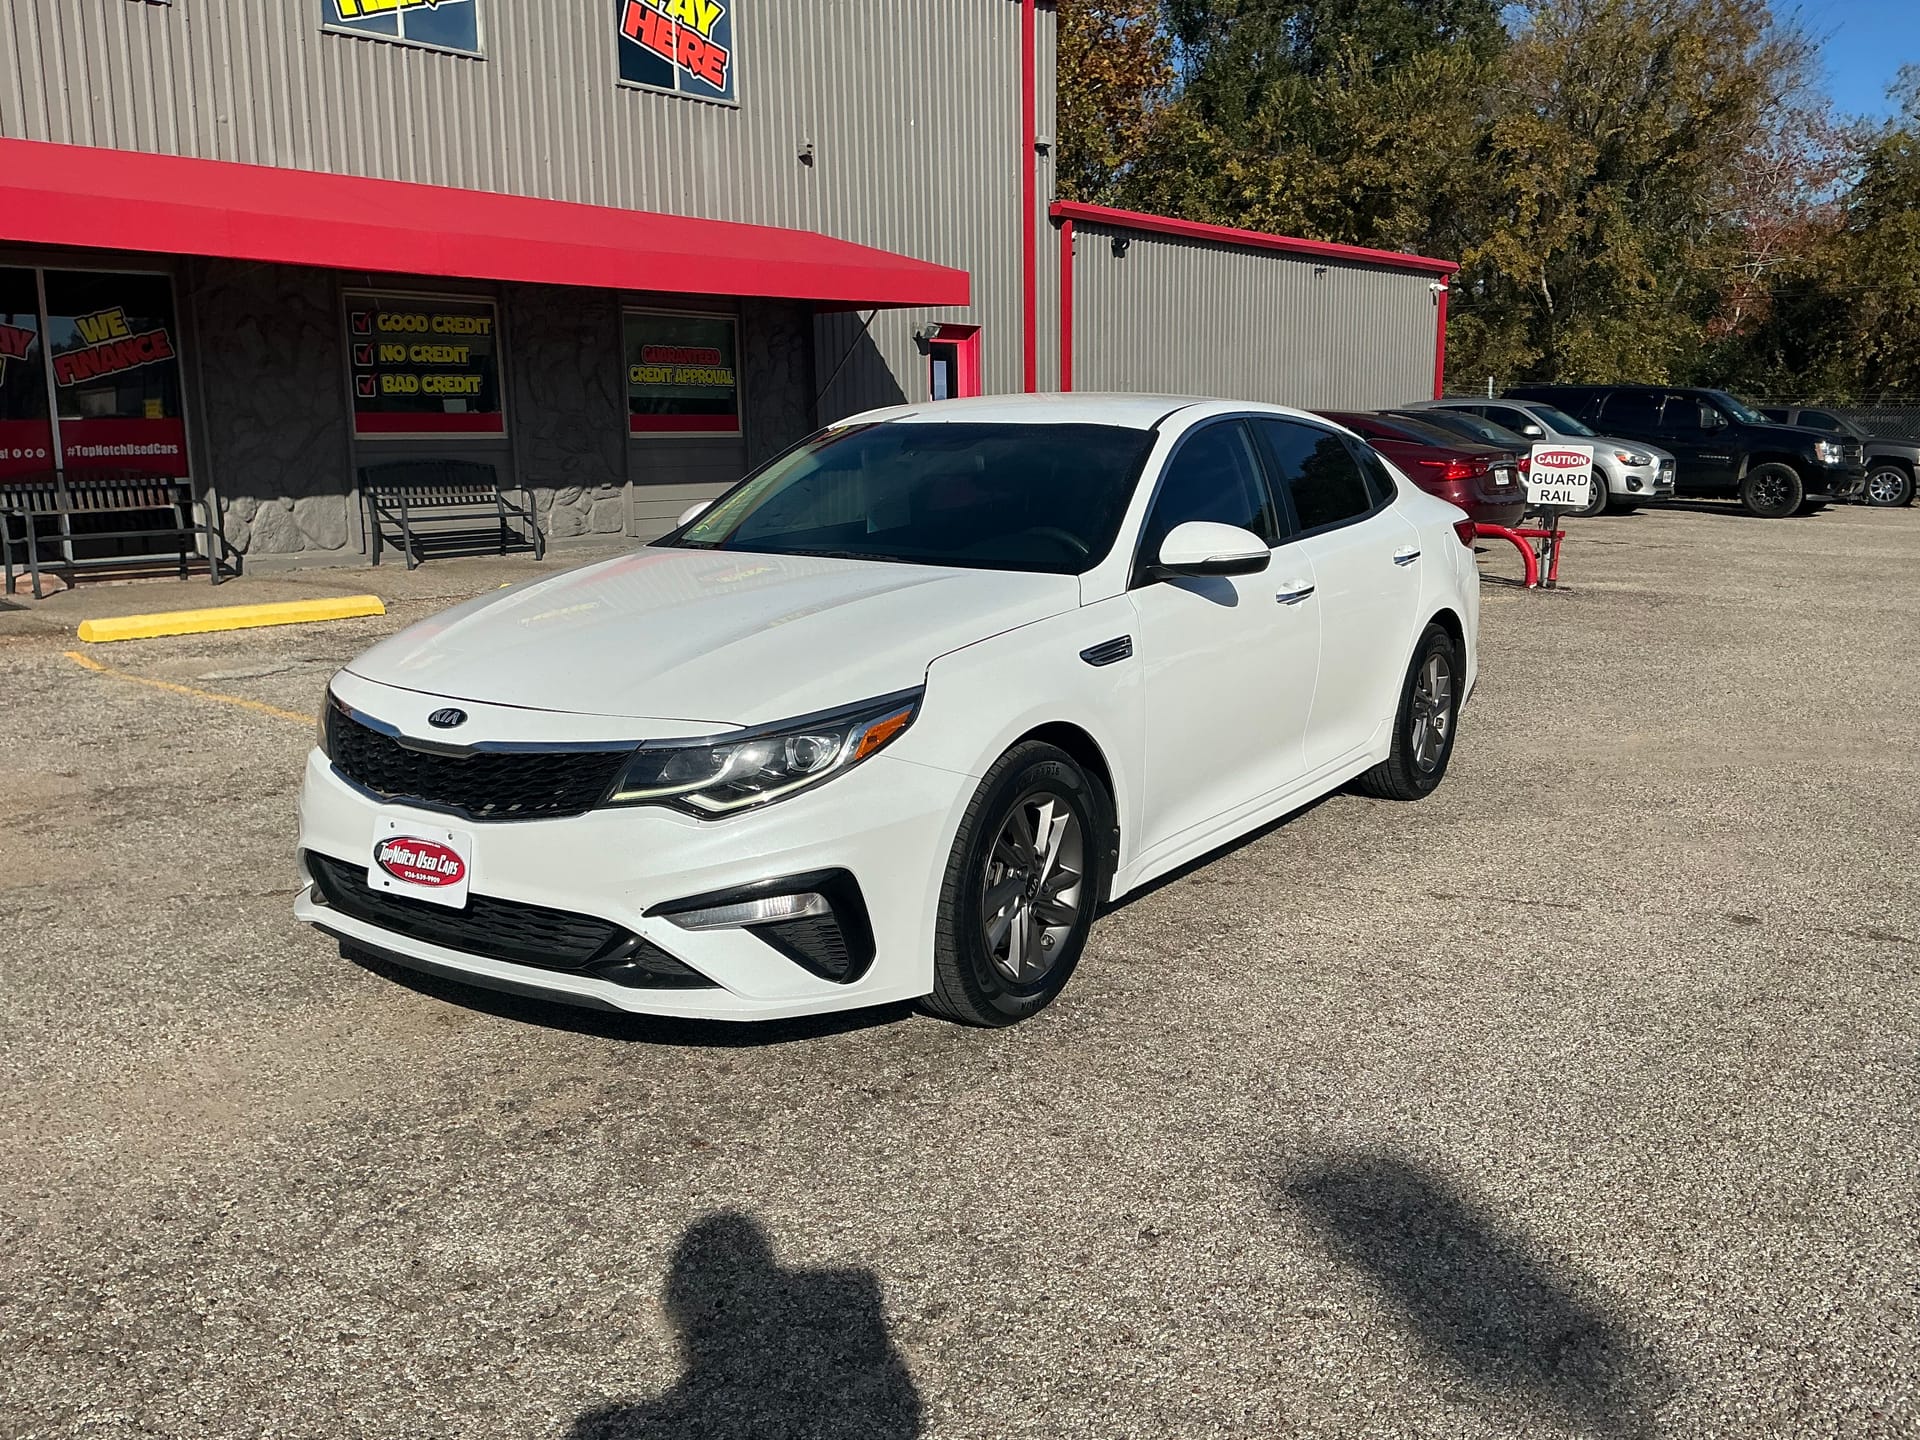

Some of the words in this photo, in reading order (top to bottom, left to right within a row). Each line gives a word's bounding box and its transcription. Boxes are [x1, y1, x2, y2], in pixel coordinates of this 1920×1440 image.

[645, 0, 723, 38] AY
[624, 0, 727, 89] HERE
[76, 309, 129, 343] WE
[378, 313, 429, 332] GOOD
[431, 316, 491, 335] CREDIT
[53, 330, 174, 385] FINANCE
[380, 344, 407, 362] NO
[410, 346, 470, 363] CREDIT
[643, 347, 720, 365] GUARANTEED
[382, 375, 419, 393] BAD
[421, 376, 481, 394] CREDIT
[630, 367, 673, 383] CREDIT
[674, 368, 734, 385] APPROVAL
[67, 443, 178, 457] #TopNotchUsedCars
[1537, 455, 1587, 465] CAUTION
[1532, 473, 1588, 486] GUARD
[1540, 489, 1576, 503] RAIL
[429, 709, 462, 725] KIA
